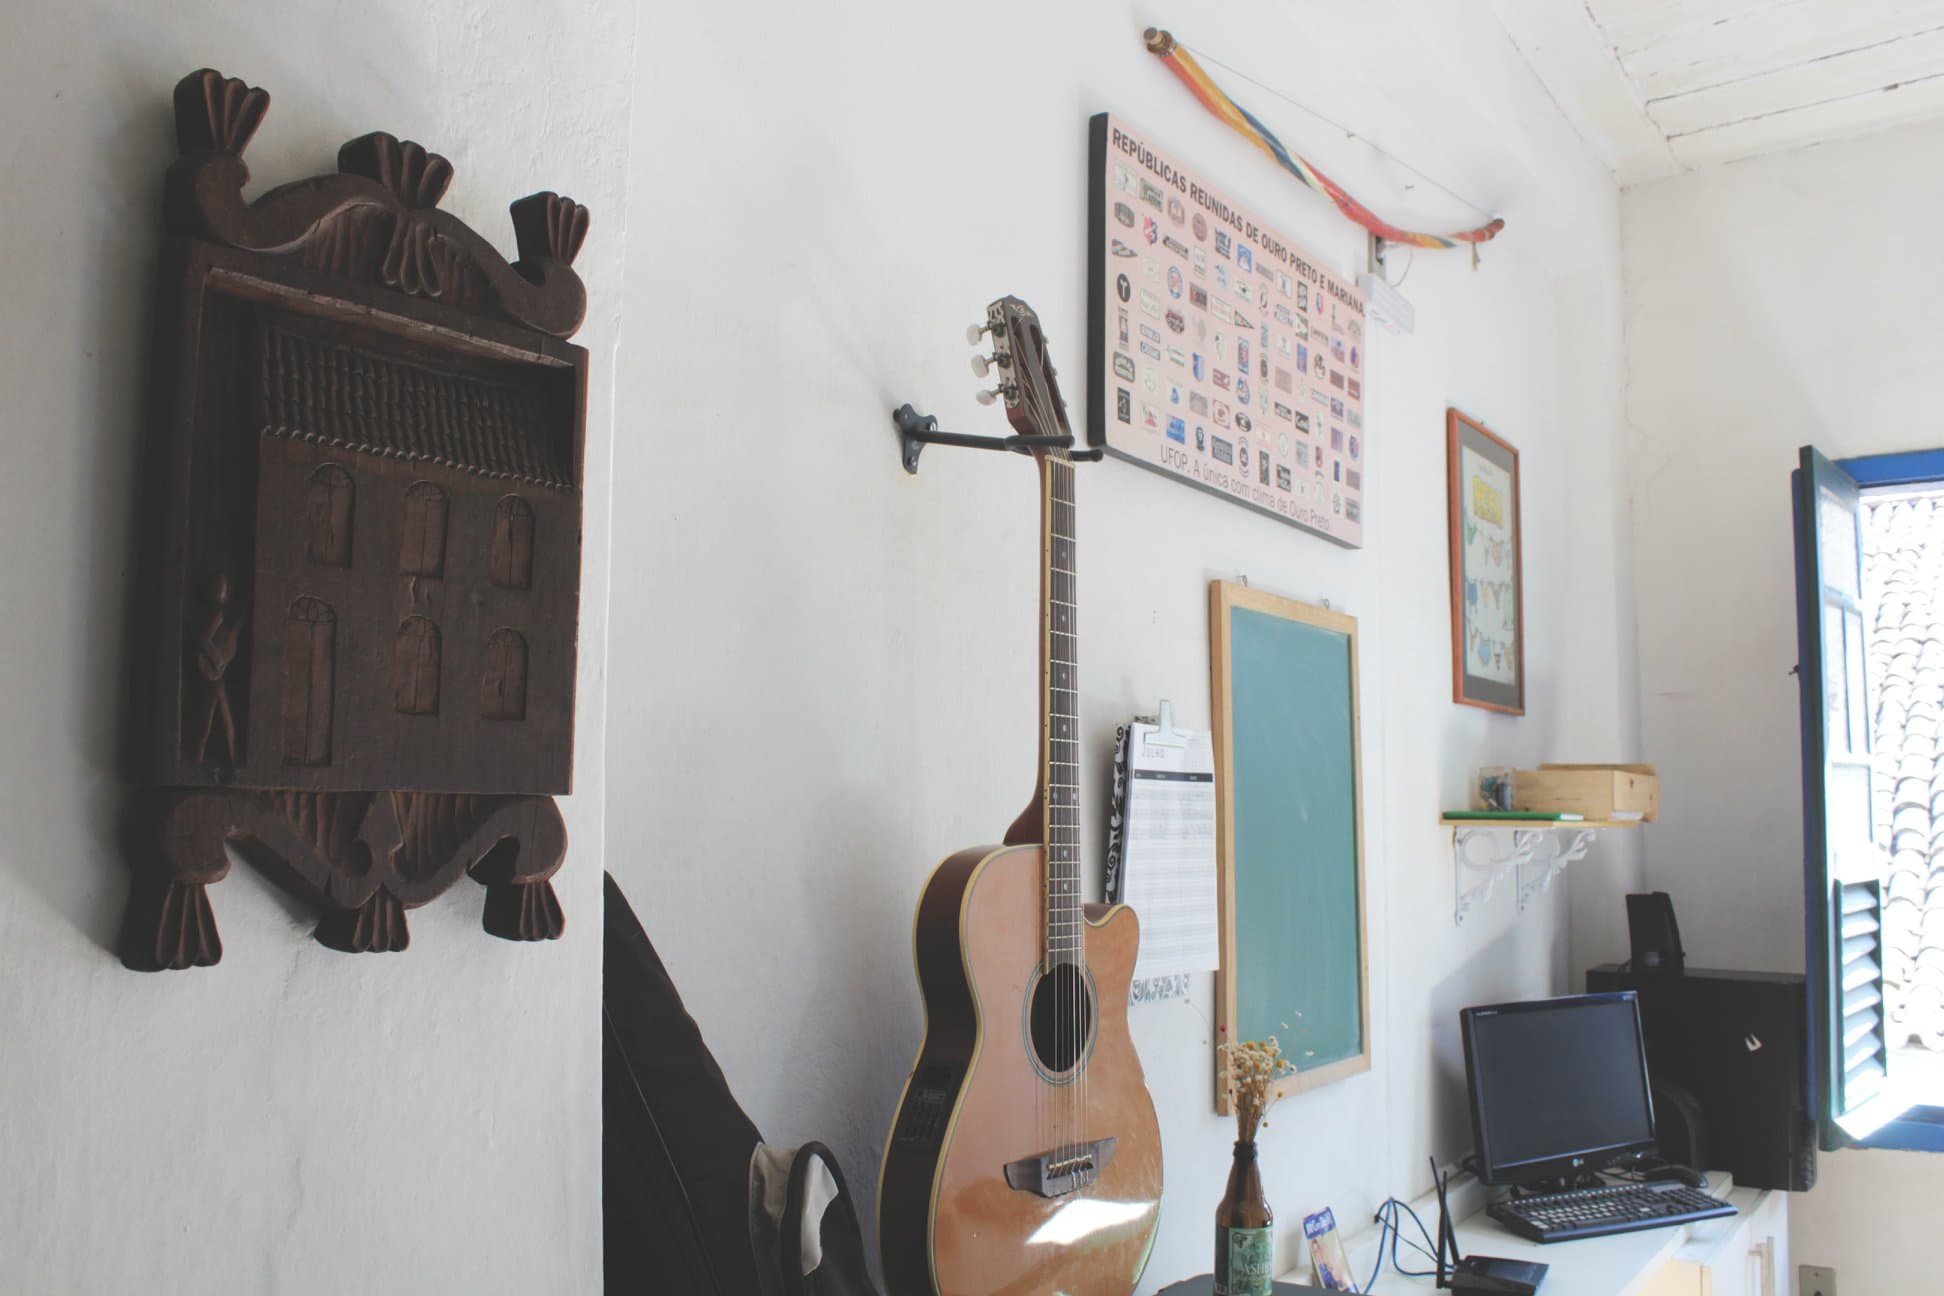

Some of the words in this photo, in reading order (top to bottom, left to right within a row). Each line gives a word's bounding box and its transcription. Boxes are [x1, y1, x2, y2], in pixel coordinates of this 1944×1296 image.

[1112, 127, 1187, 194] REPÚBLICAS
[1190, 181, 1244, 233] REUNIDAS
[1246, 221, 1259, 244] DE
[1261, 232, 1288, 263] OURO
[1289, 253, 1318, 284] PRETO
[1320, 274, 1326, 289] E
[1327, 279, 1366, 317] MARIANA
[1193, 458, 1200, 477] A
[1203, 463, 1229, 489] única
[1231, 479, 1250, 497] com
[1289, 499, 1309, 523] Ouro
